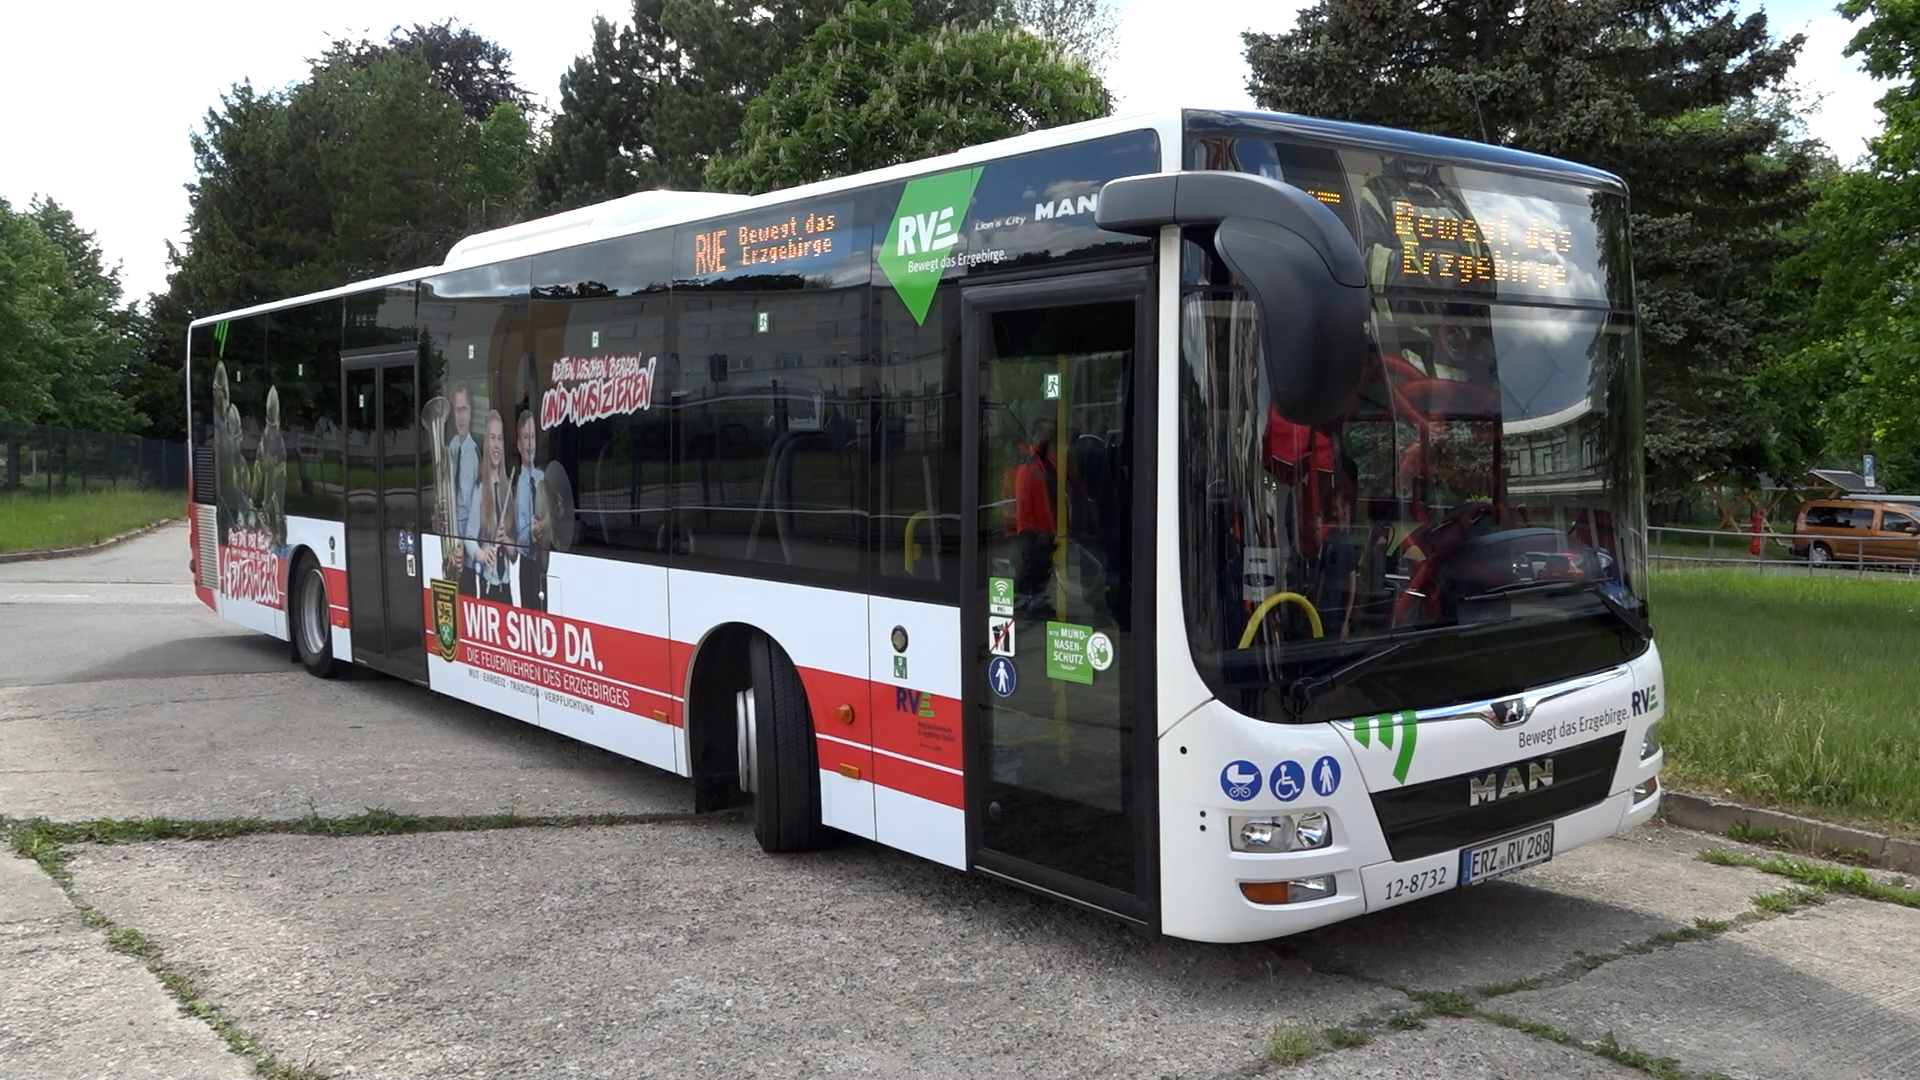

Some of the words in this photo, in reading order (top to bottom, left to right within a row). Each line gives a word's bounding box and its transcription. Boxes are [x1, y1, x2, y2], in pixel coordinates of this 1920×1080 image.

[975, 219, 1001, 231] Lion's
[1005, 215, 1027, 227] City
[1034, 193, 1098, 221] MAN
[738, 216, 797, 246] Bewegt
[805, 212, 835, 234] das
[897, 206, 959, 257] RVE
[1395, 200, 1510, 247] Bewegt
[1525, 217, 1572, 253] das
[695, 229, 727, 276] RVE
[741, 236, 832, 266] Erzgebirge
[908, 259, 939, 273] Bewegt
[940, 254, 956, 269] das
[957, 249, 1008, 266] Erzgebirge.
[1402, 240, 1566, 289] Erzgebirge
[992, 595, 1011, 605] WLAN
[463, 601, 502, 645] WIR
[506, 610, 557, 658] SIND
[563, 622, 604, 672] DA.
[1053, 639, 1083, 652] NASEN-
[1060, 627, 1088, 640] MUND-
[1053, 650, 1084, 665] SCHUTZ
[466, 646, 481, 666] DIE
[481, 652, 541, 683] FEUERWEHREN
[543, 667, 562, 688] DES
[563, 673, 630, 709] ERZGEBIRGES
[468, 669, 480, 678] MUT
[483, 673, 506, 688] EHRGEIZ
[509, 680, 540, 699] TRADITION
[544, 691, 595, 716] VERPFLICHTUNG
[896, 686, 934, 718] RVE
[1631, 685, 1659, 717] RVE
[1518, 728, 1557, 748] Bewegt
[1559, 719, 1578, 738] das
[1579, 706, 1630, 733] Erzgebirge.
[1470, 757, 1554, 807] MAN
[1471, 847, 1499, 877] ERZ
[1507, 840, 1525, 866] RV
[1527, 830, 1550, 860] 288
[1385, 866, 1447, 900] 12-8732
